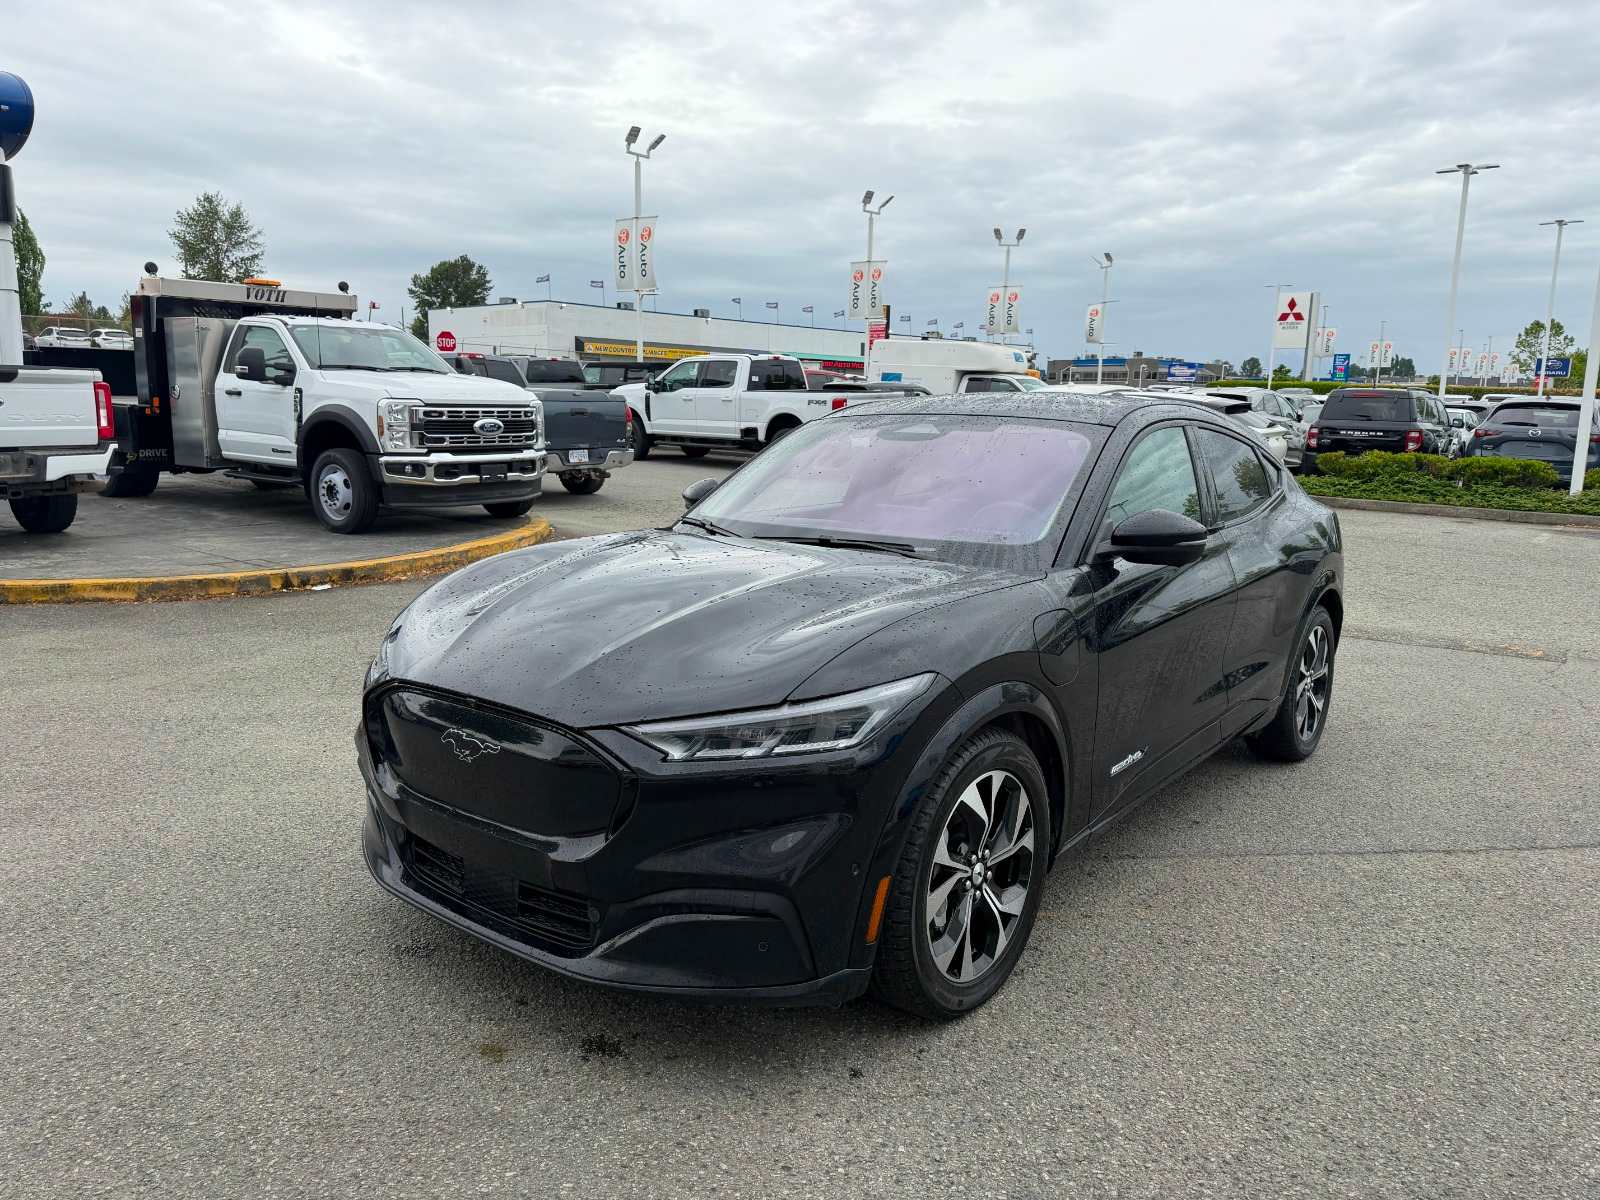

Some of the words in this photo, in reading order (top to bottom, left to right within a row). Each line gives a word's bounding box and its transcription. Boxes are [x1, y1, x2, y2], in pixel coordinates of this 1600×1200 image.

[618, 245, 626, 279] Auto
[640, 243, 648, 278] Auto
[246, 287, 287, 302] VOTH
[852, 282, 860, 309] Auto
[437, 337, 455, 348] STOP
